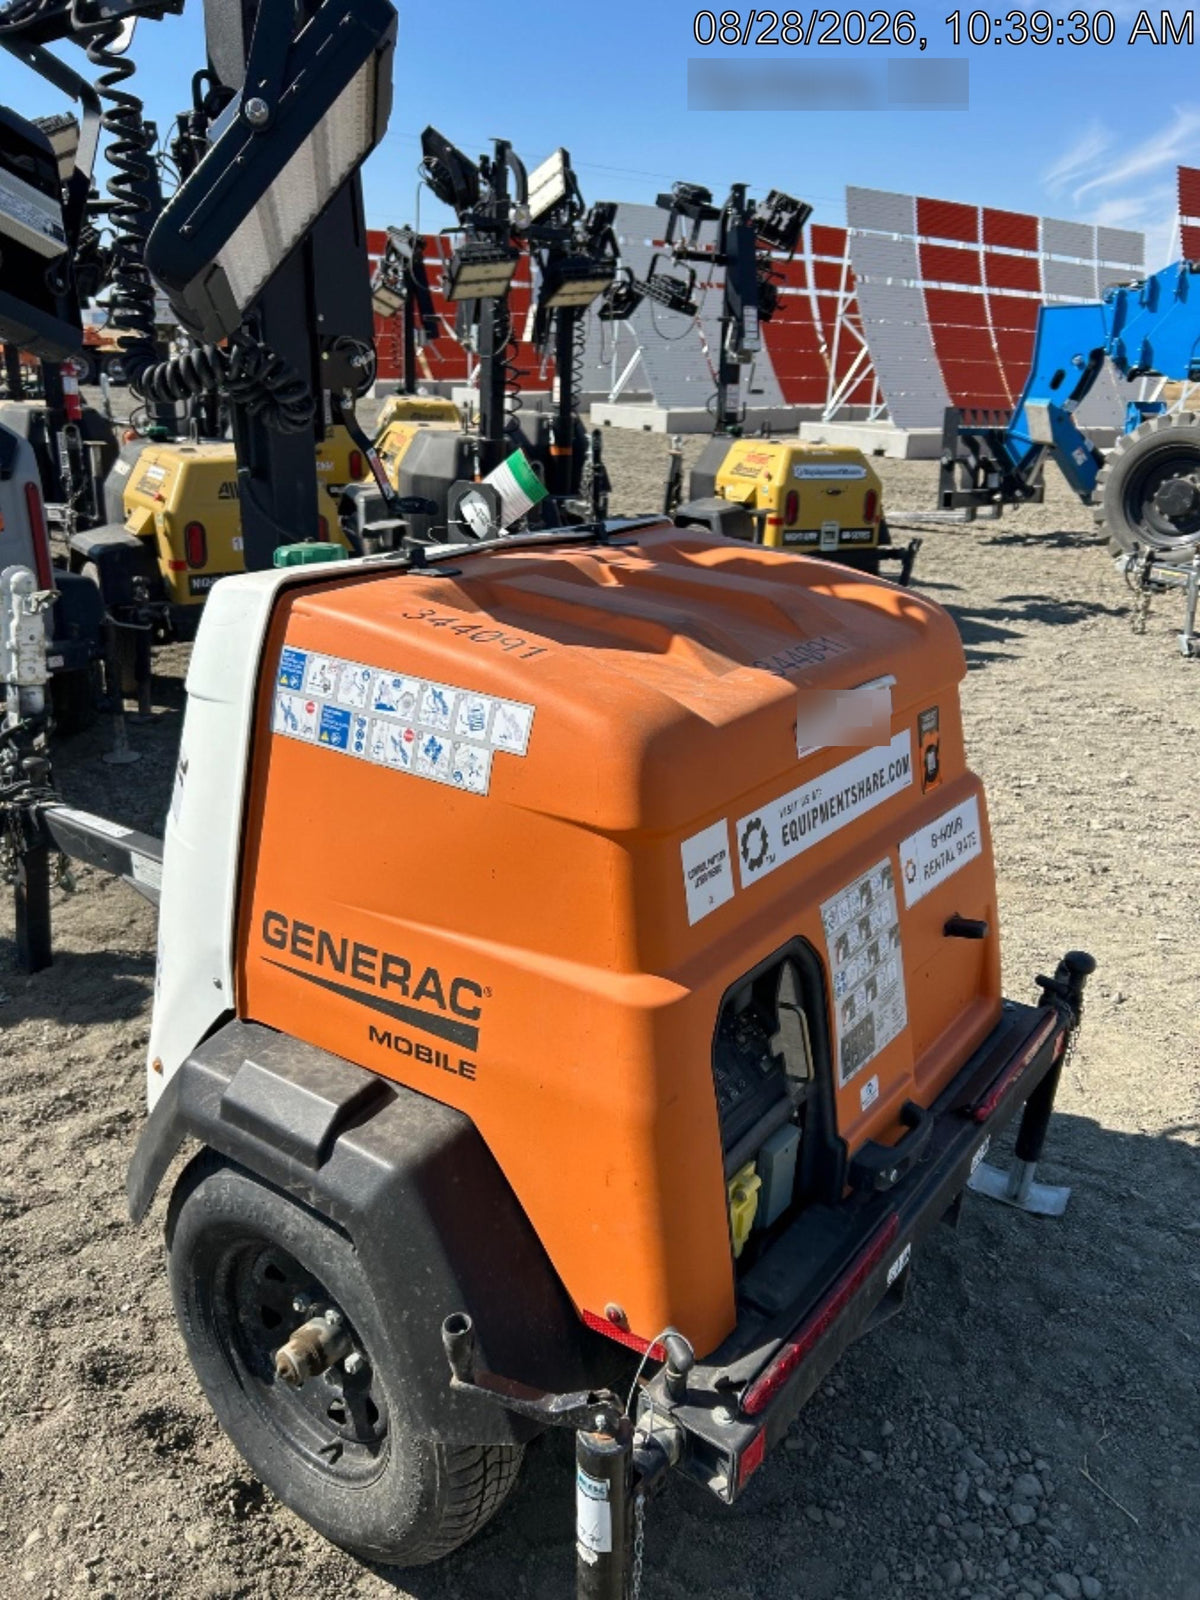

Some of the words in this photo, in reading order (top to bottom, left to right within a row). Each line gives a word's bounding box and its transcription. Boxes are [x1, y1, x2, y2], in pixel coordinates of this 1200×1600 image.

[402, 607, 549, 660] 344091
[778, 799, 798, 819] VISIT
[781, 753, 911, 847] EQUIPMENTSHARE.COM
[922, 848, 957, 881] RENTAL
[956, 830, 978, 855] RATE
[931, 816, 963, 849] 8-HOUR
[368, 1024, 478, 1082] MOBILE
